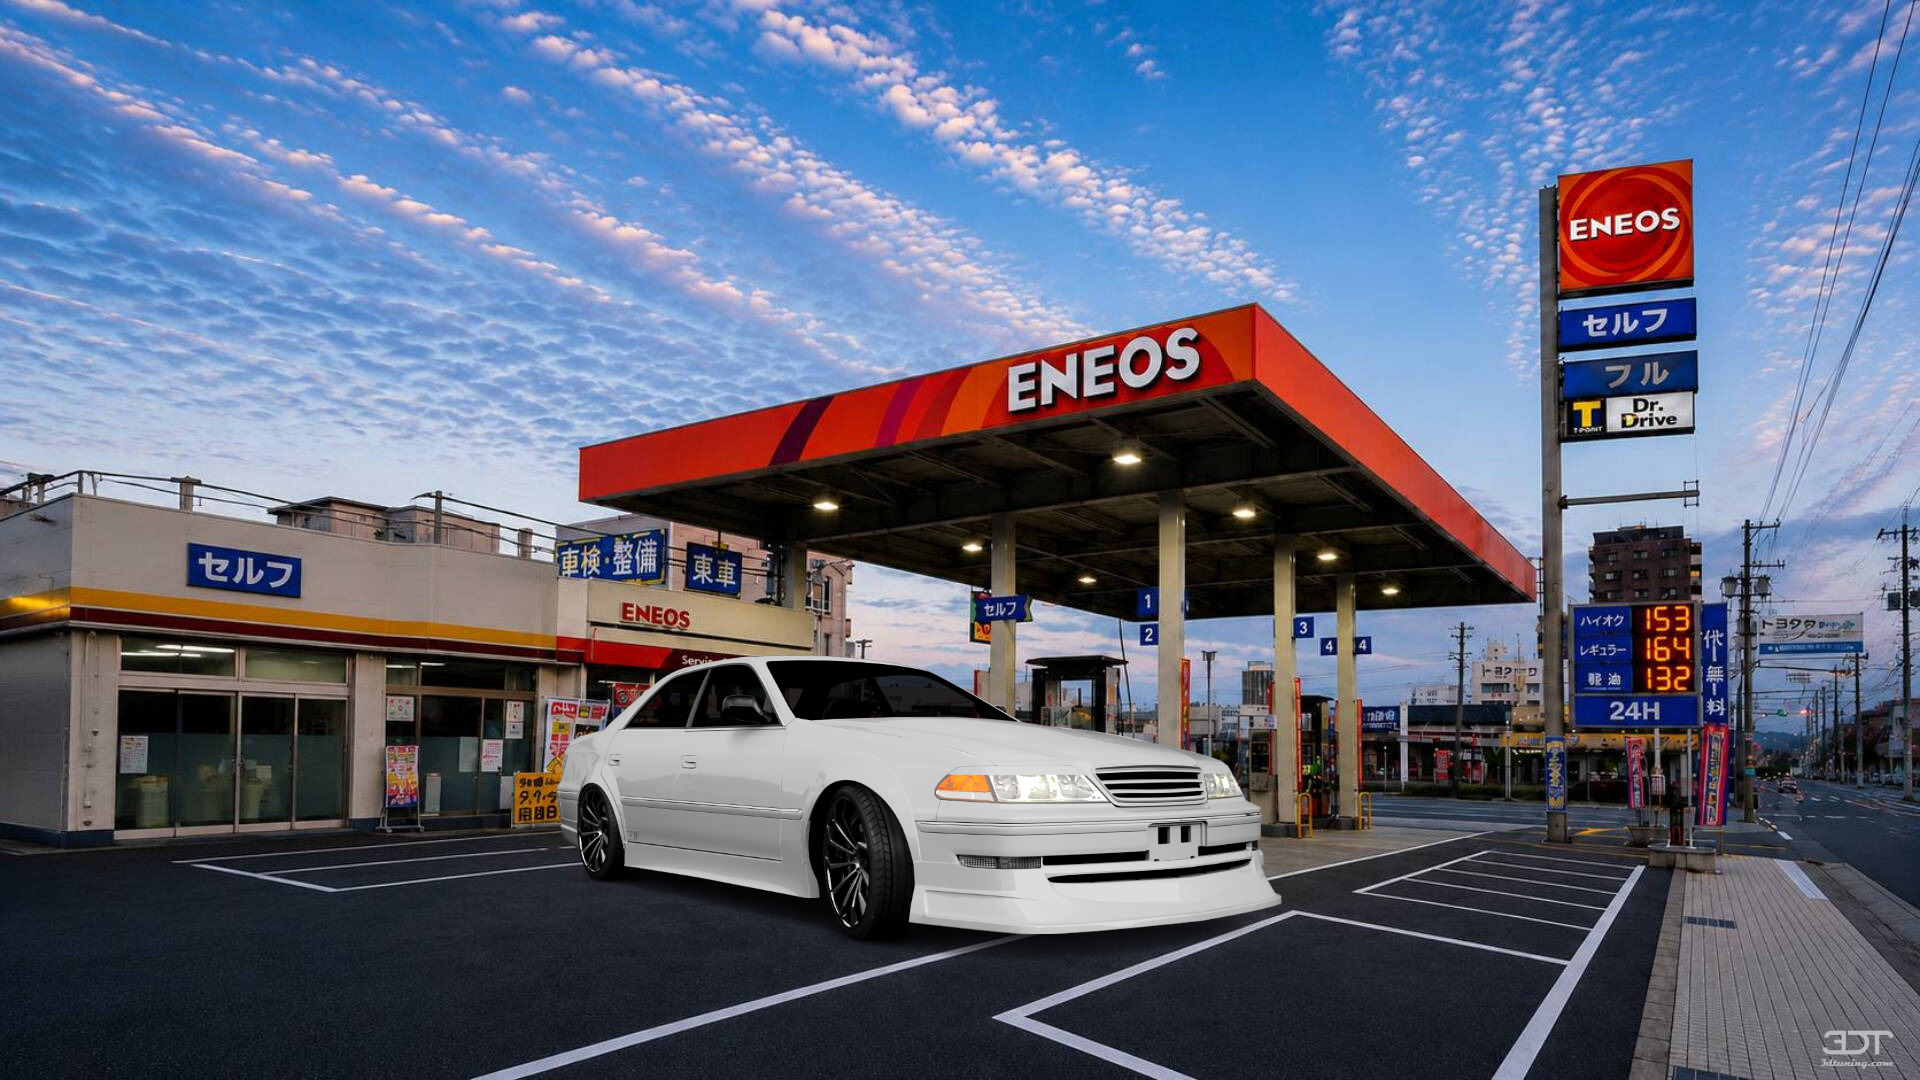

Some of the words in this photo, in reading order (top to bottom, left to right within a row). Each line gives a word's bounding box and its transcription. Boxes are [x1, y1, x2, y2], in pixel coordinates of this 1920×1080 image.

[1569, 207, 1681, 241] ENEOS
[1582, 309, 1668, 337] セルフ
[1006, 327, 1201, 412] ENEOS
[1604, 360, 1670, 389] フル
[1572, 400, 1601, 427] T
[1632, 398, 1664, 413] Dr.
[1620, 412, 1678, 429] Drive
[197, 551, 295, 588] セルフ
[984, 602, 1016, 617] セルフ
[1144, 594, 1151, 609] 1
[621, 602, 691, 629] ENEOS
[1580, 614, 1624, 628] ハイオク
[1646, 605, 1690, 632] 153
[1144, 628, 1153, 642] 2
[1299, 621, 1308, 635] 3
[1325, 639, 1333, 653] 4
[1358, 639, 1367, 651] 4
[1580, 644, 1626, 657] レギュラー
[1646, 636, 1690, 662] 164
[1646, 666, 1690, 691] 132
[1609, 701, 1661, 721] 24H
